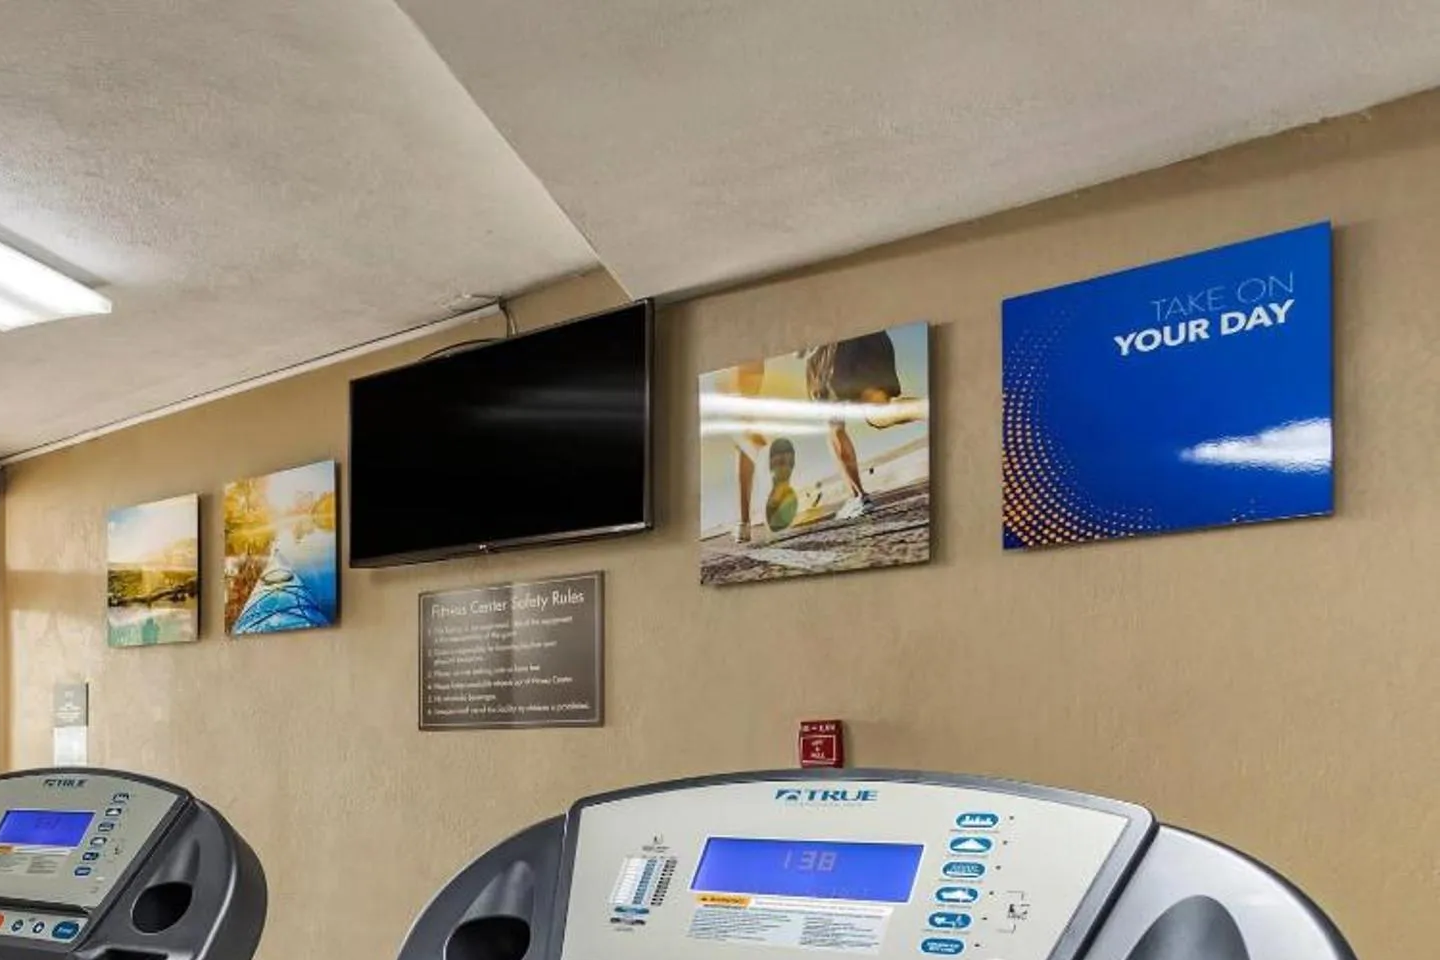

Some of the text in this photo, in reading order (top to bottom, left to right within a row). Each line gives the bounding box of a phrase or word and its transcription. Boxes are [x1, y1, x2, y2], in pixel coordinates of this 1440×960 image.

[1152, 272, 1295, 322] TAKE ON
[1114, 298, 1296, 357] YOUR DAY
[430, 587, 585, 620] Fitness Center Safety Rules
[805, 789, 880, 802] TRUE
